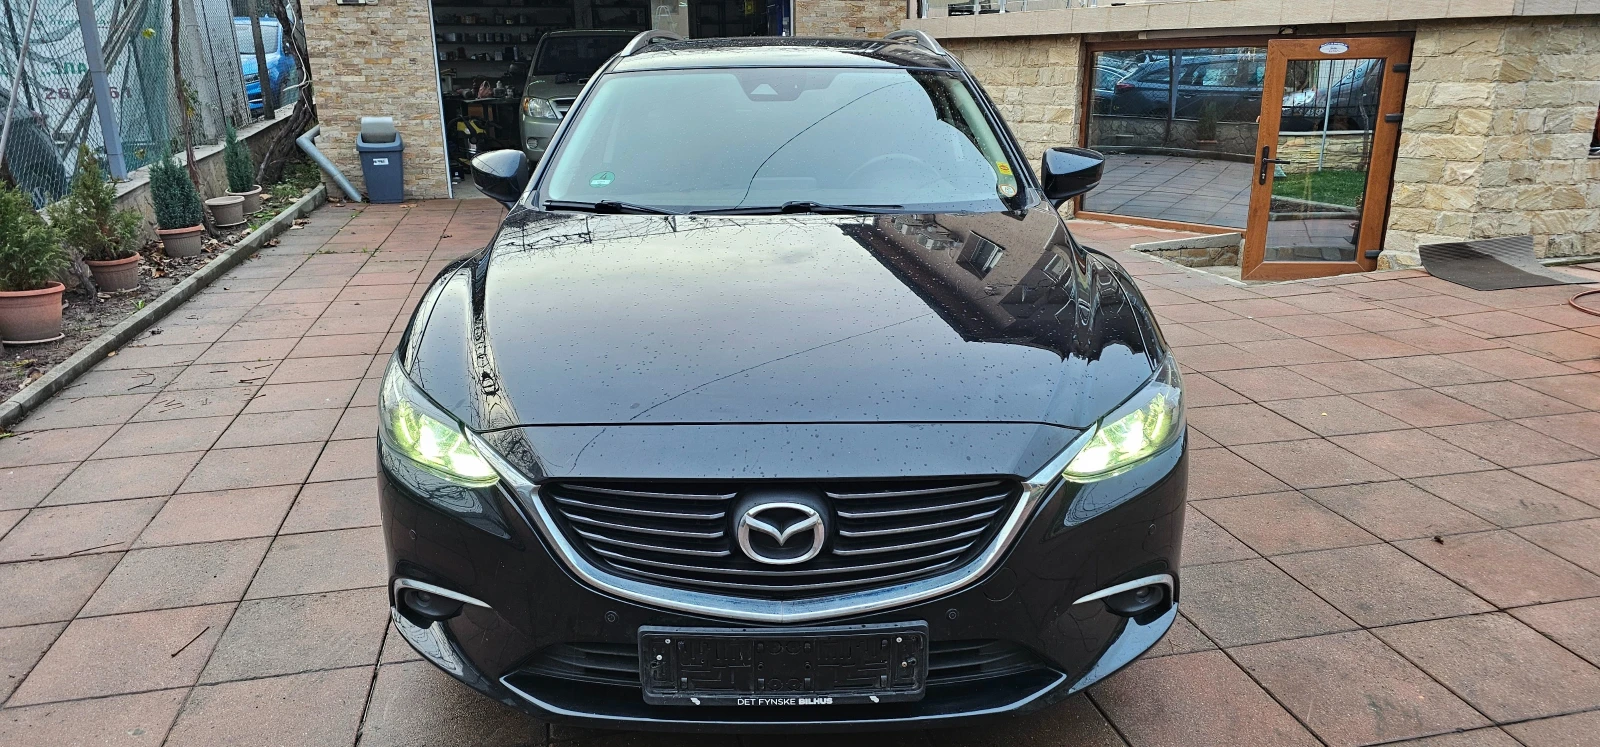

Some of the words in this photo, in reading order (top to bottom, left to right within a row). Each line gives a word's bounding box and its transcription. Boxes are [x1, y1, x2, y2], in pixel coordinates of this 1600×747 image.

[737, 698, 756, 706] DET
[758, 698, 796, 706] FYNSKE
[798, 697, 833, 705] BILHUS
